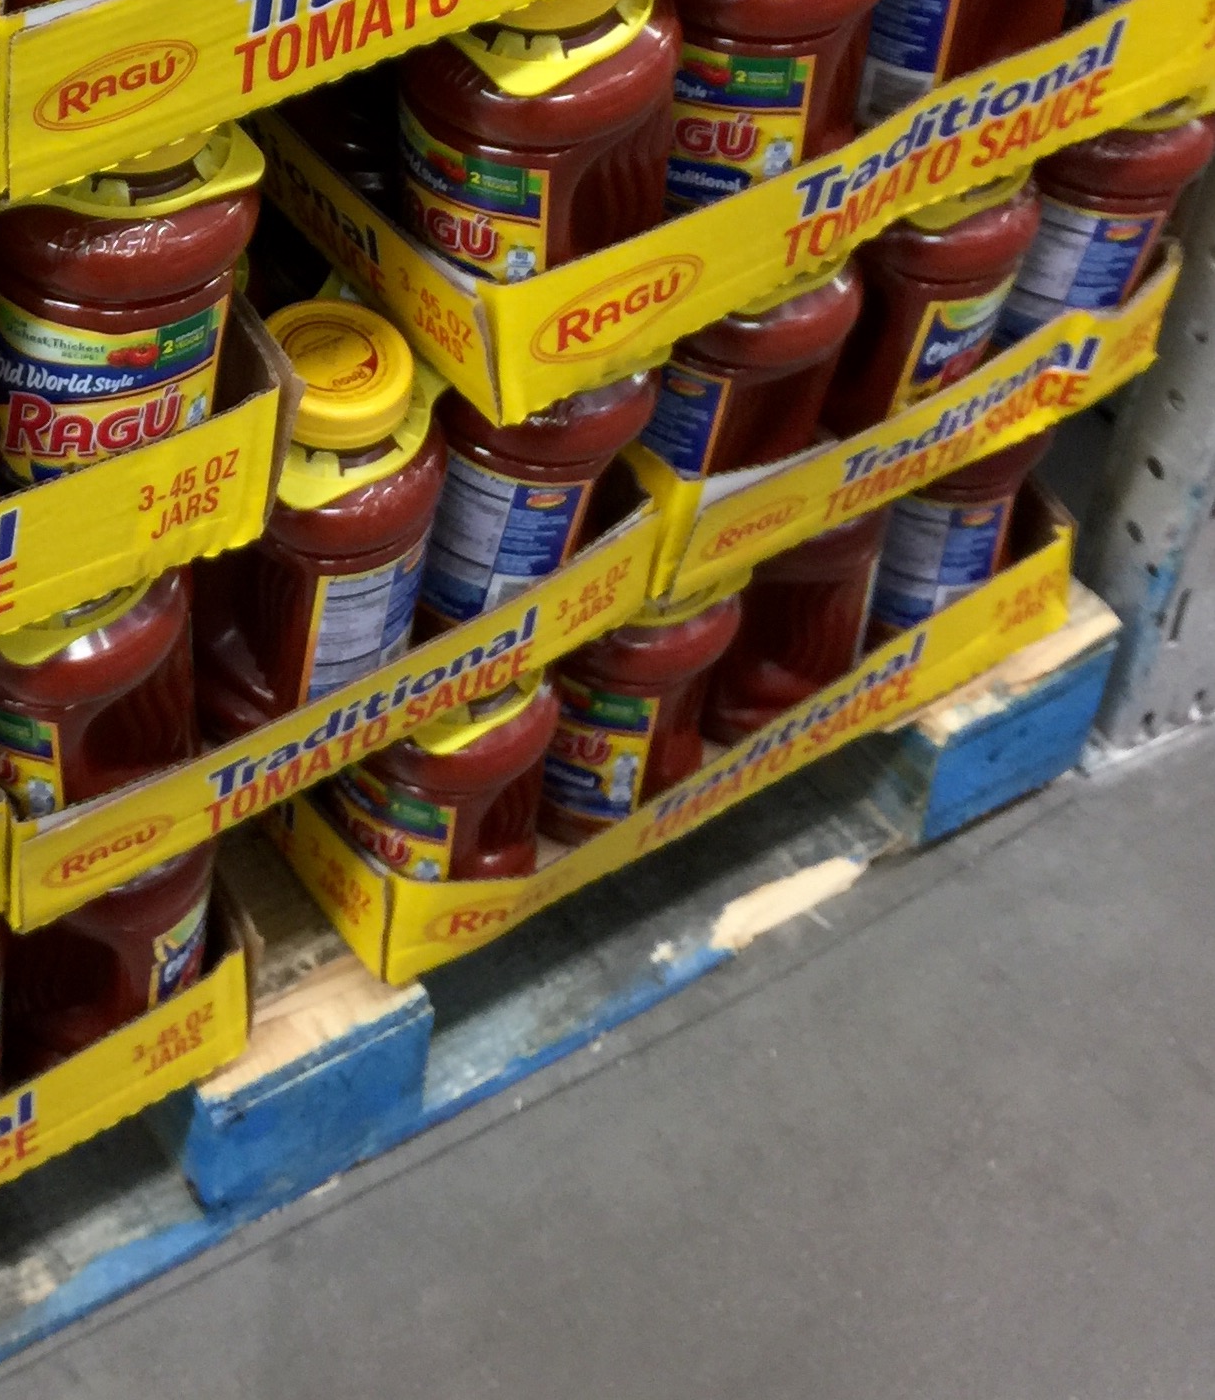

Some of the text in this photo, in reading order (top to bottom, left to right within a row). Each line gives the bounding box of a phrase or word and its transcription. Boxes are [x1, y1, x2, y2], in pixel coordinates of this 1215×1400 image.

[55, 59, 177, 120] RAGÚ
[798, 16, 1129, 217] Traditional
[470, 172, 481, 184] 2
[784, 136, 961, 266] TOMATO
[971, 69, 1113, 168] SAUCE
[415, 307, 465, 364] JARS
[555, 267, 681, 353] RAGÚ
[51, 338, 105, 354] Thickest
[162, 340, 175, 353] 2
[27, 365, 91, 394] World
[93, 375, 134, 393] Style
[4, 384, 183, 457] RAGÚ
[138, 448, 241, 512] 3-45 OZ
[150, 484, 220, 540] JARS
[605, 556, 631, 589] OZ
[564, 589, 616, 636] JARS
[209, 606, 538, 798] Traditional
[204, 642, 534, 833] TOMATO SAUCE
